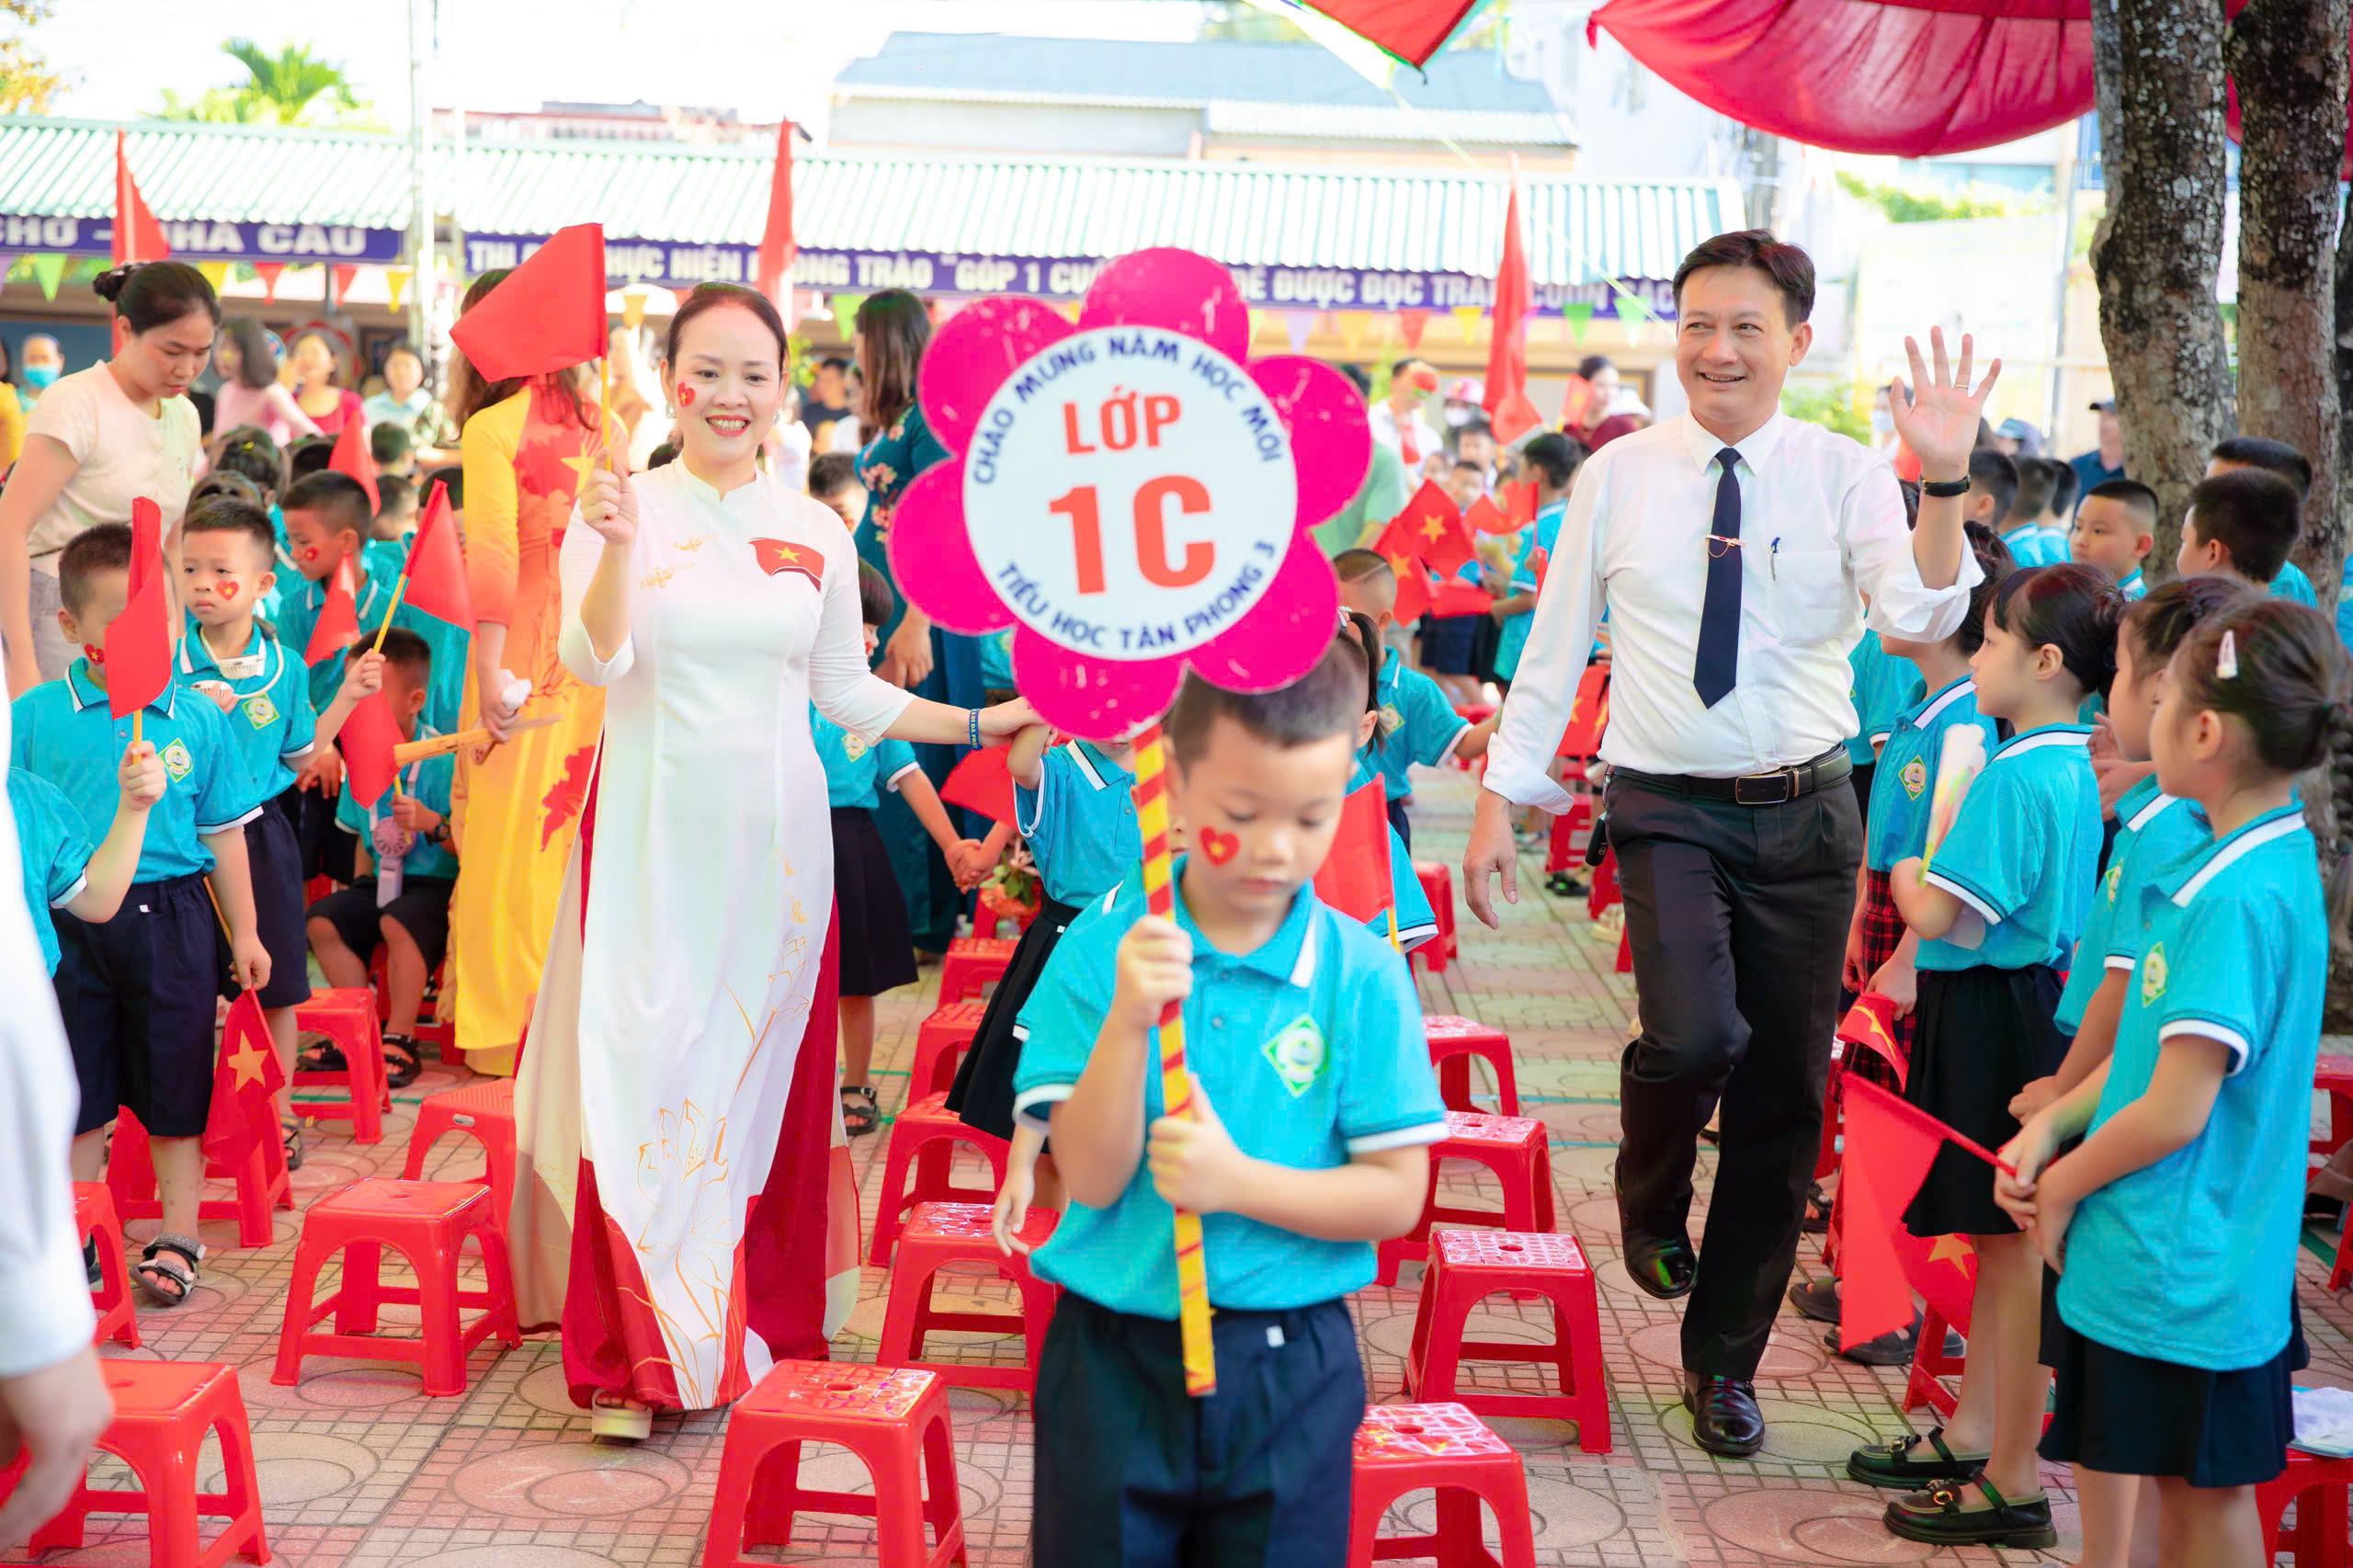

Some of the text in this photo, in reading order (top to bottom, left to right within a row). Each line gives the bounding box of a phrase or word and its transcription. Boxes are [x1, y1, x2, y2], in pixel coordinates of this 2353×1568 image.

[1063, 384, 1181, 455] LỚP
[1184, 562, 1264, 636] PHONG
[1254, 540, 1276, 559] 3
